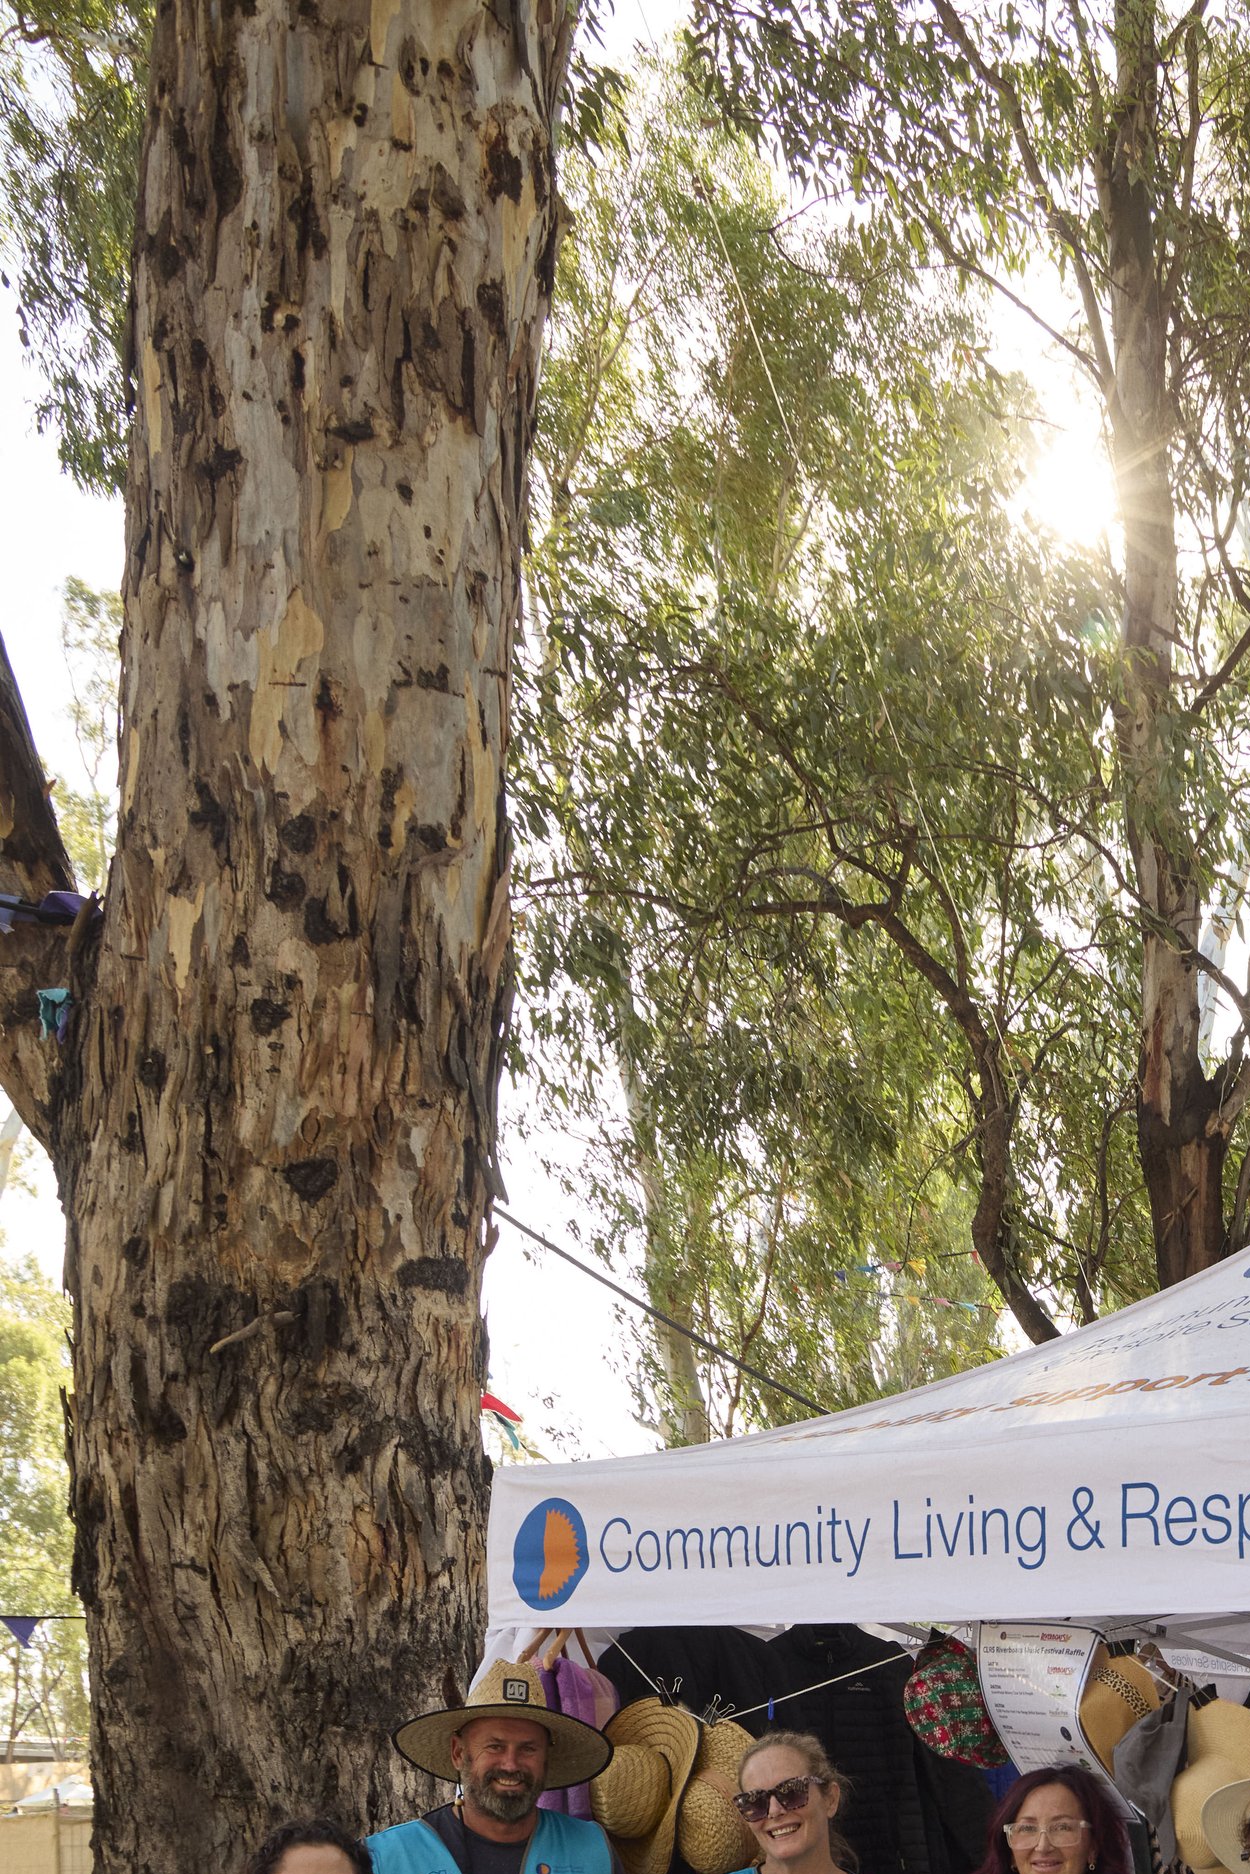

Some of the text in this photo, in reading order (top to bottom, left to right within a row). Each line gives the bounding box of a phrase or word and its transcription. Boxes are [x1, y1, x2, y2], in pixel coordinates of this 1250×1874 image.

[600, 1505, 871, 1578] Community
[893, 1494, 1047, 1570] Living
[1066, 1486, 1105, 1551] &
